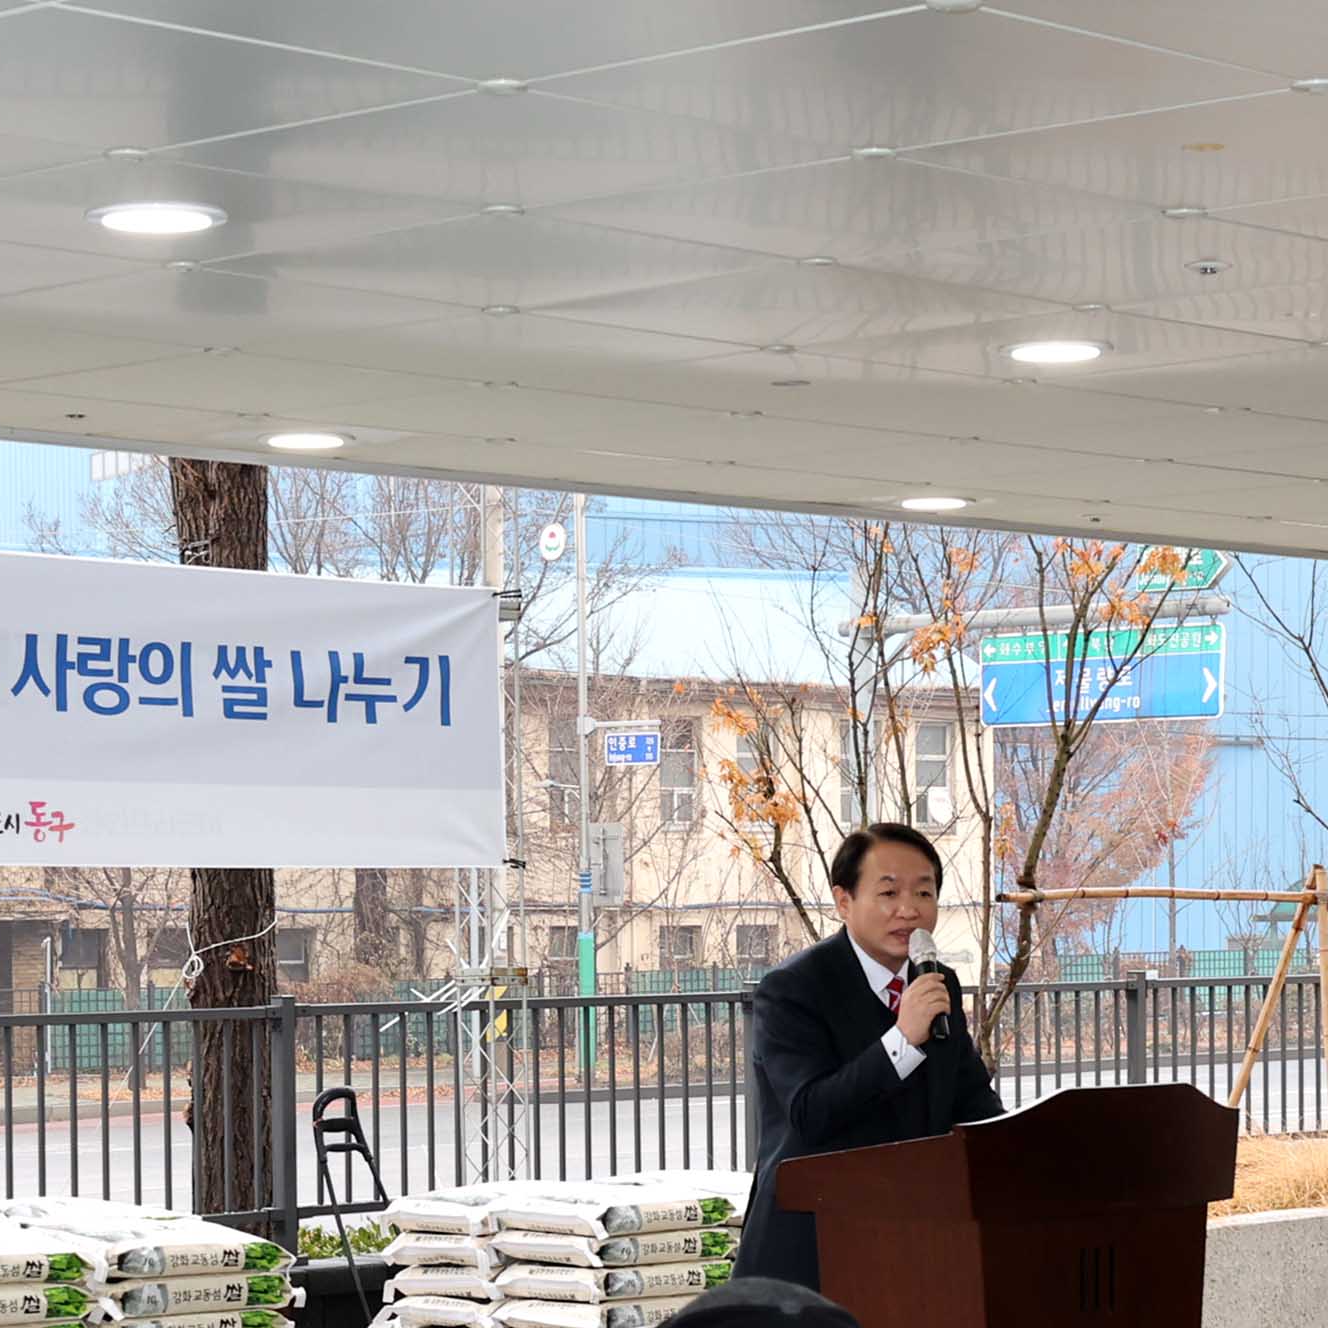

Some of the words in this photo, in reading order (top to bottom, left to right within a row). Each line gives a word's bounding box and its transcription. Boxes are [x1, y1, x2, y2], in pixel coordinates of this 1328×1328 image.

[10, 633, 194, 718] 사랑의
[212, 644, 272, 721] 쌀
[290, 649, 451, 726] 나누기
[24, 801, 76, 843] 동구
